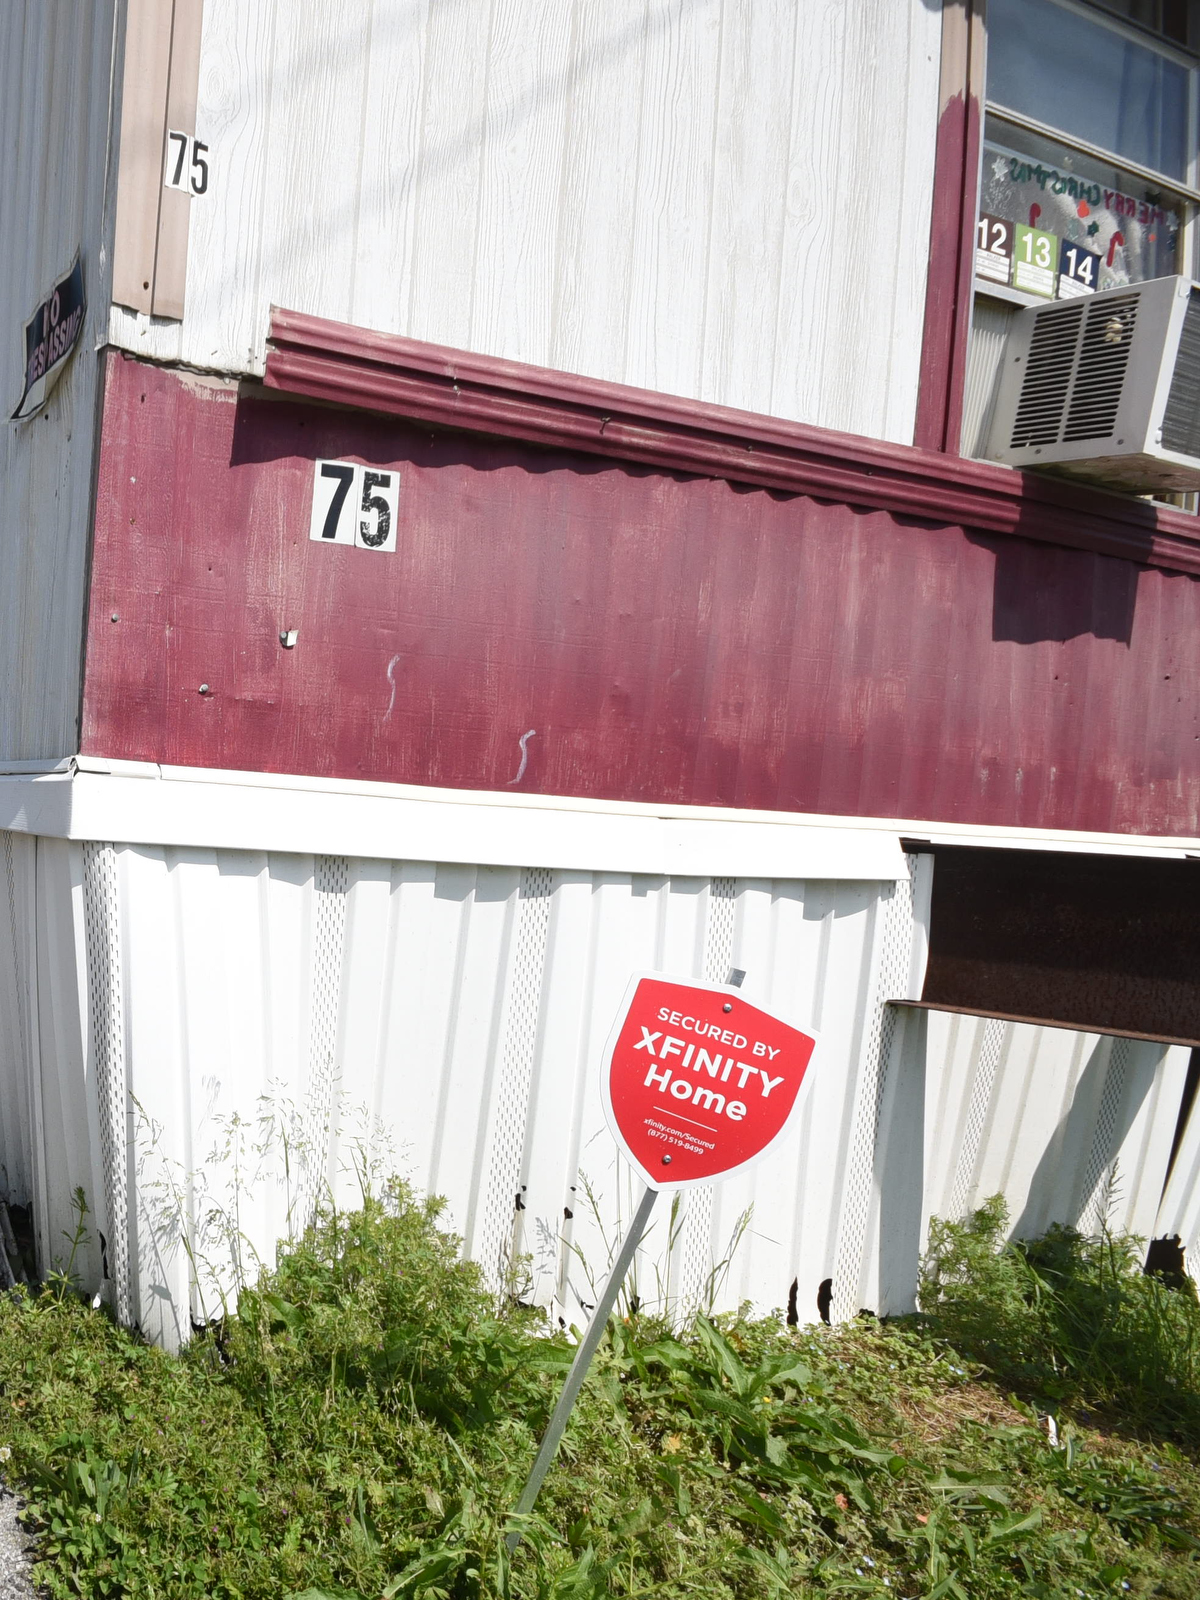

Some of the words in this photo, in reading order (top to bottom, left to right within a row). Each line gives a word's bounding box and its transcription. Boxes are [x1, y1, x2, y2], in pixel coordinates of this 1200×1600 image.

[168, 131, 209, 195] 75
[977, 218, 1007, 256] 12
[1021, 232, 1051, 268] 13
[1065, 248, 1094, 286] 14
[319, 463, 392, 548] 75
[657, 1006, 748, 1050] SECURED
[751, 1041, 781, 1061] BY
[632, 1025, 785, 1098] XFINITY
[643, 1063, 748, 1121] Home
[643, 1118, 716, 1150] xfinity.com/Secured
[647, 1128, 669, 1142] (877)
[668, 1136, 704, 1155] 519-8499
